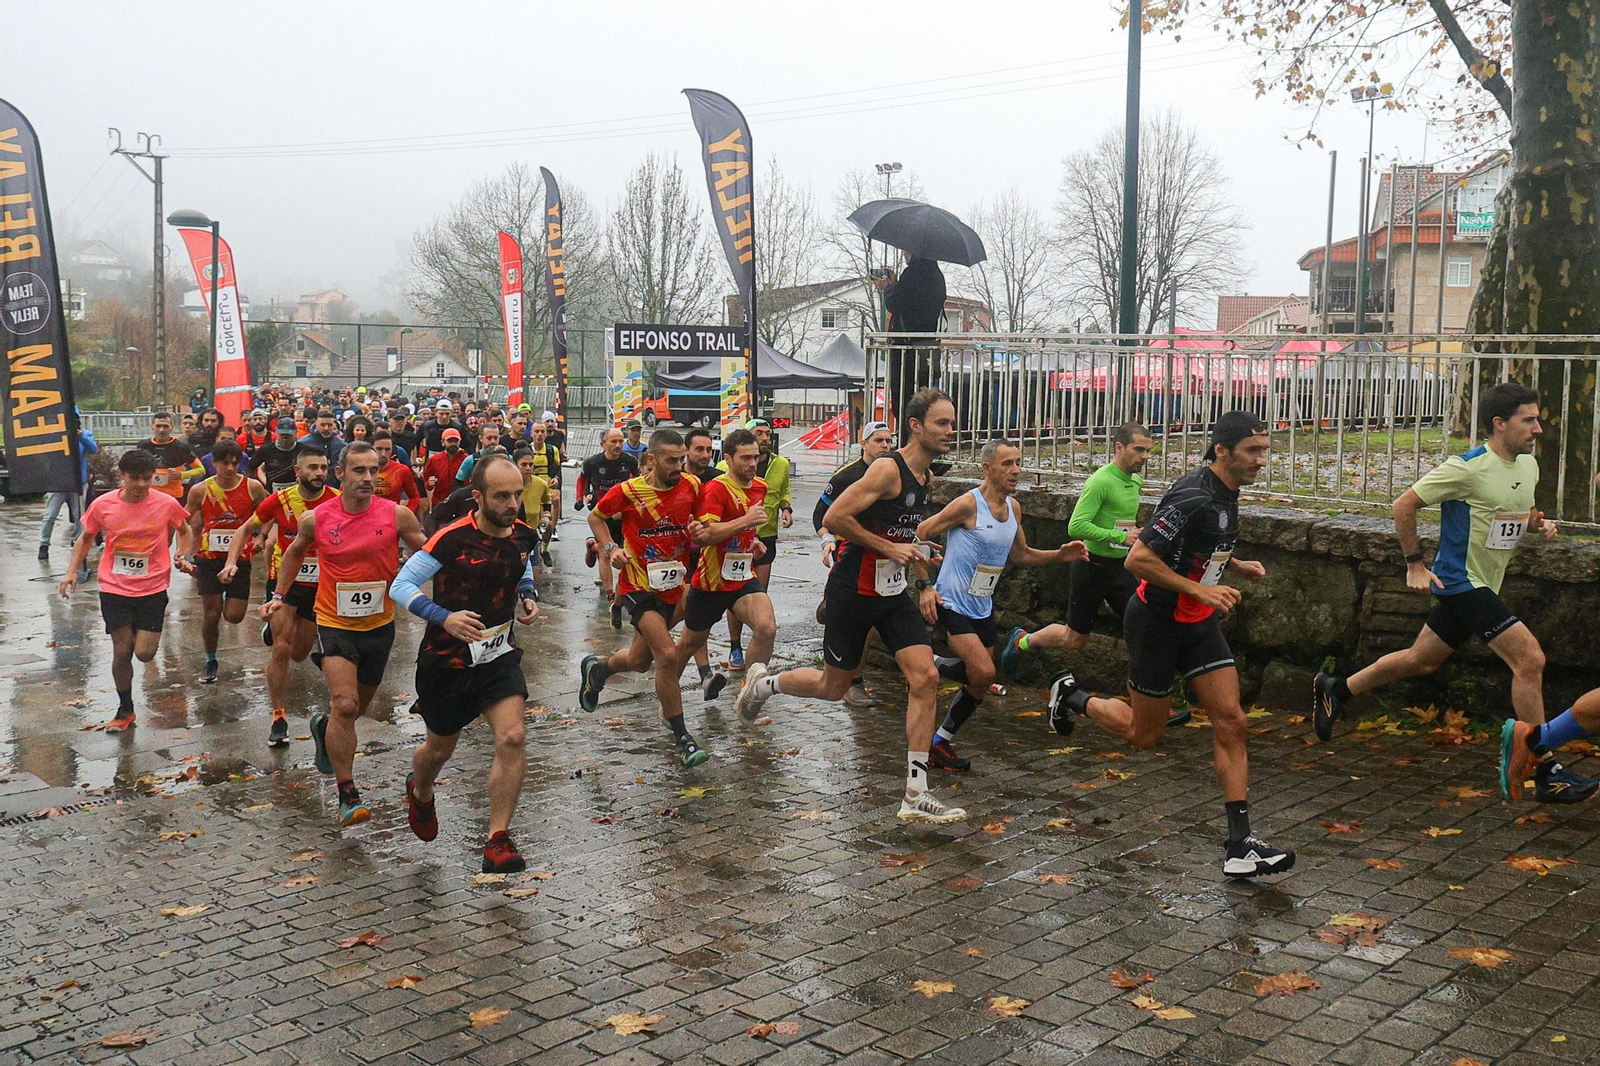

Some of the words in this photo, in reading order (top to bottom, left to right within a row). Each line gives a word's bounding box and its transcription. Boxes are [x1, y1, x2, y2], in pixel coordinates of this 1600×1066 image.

[620, 330, 691, 350] EIFONSO
[696, 332, 740, 351] TRAIL
[1164, 505, 1189, 529] 700
[1500, 522, 1522, 537] 131
[216, 535, 233, 544] 16
[121, 557, 144, 569] 166
[301, 564, 317, 574] 87
[732, 561, 745, 572] 94
[661, 569, 677, 581] 79
[989, 575, 995, 587] 1
[350, 592, 372, 605] 49
